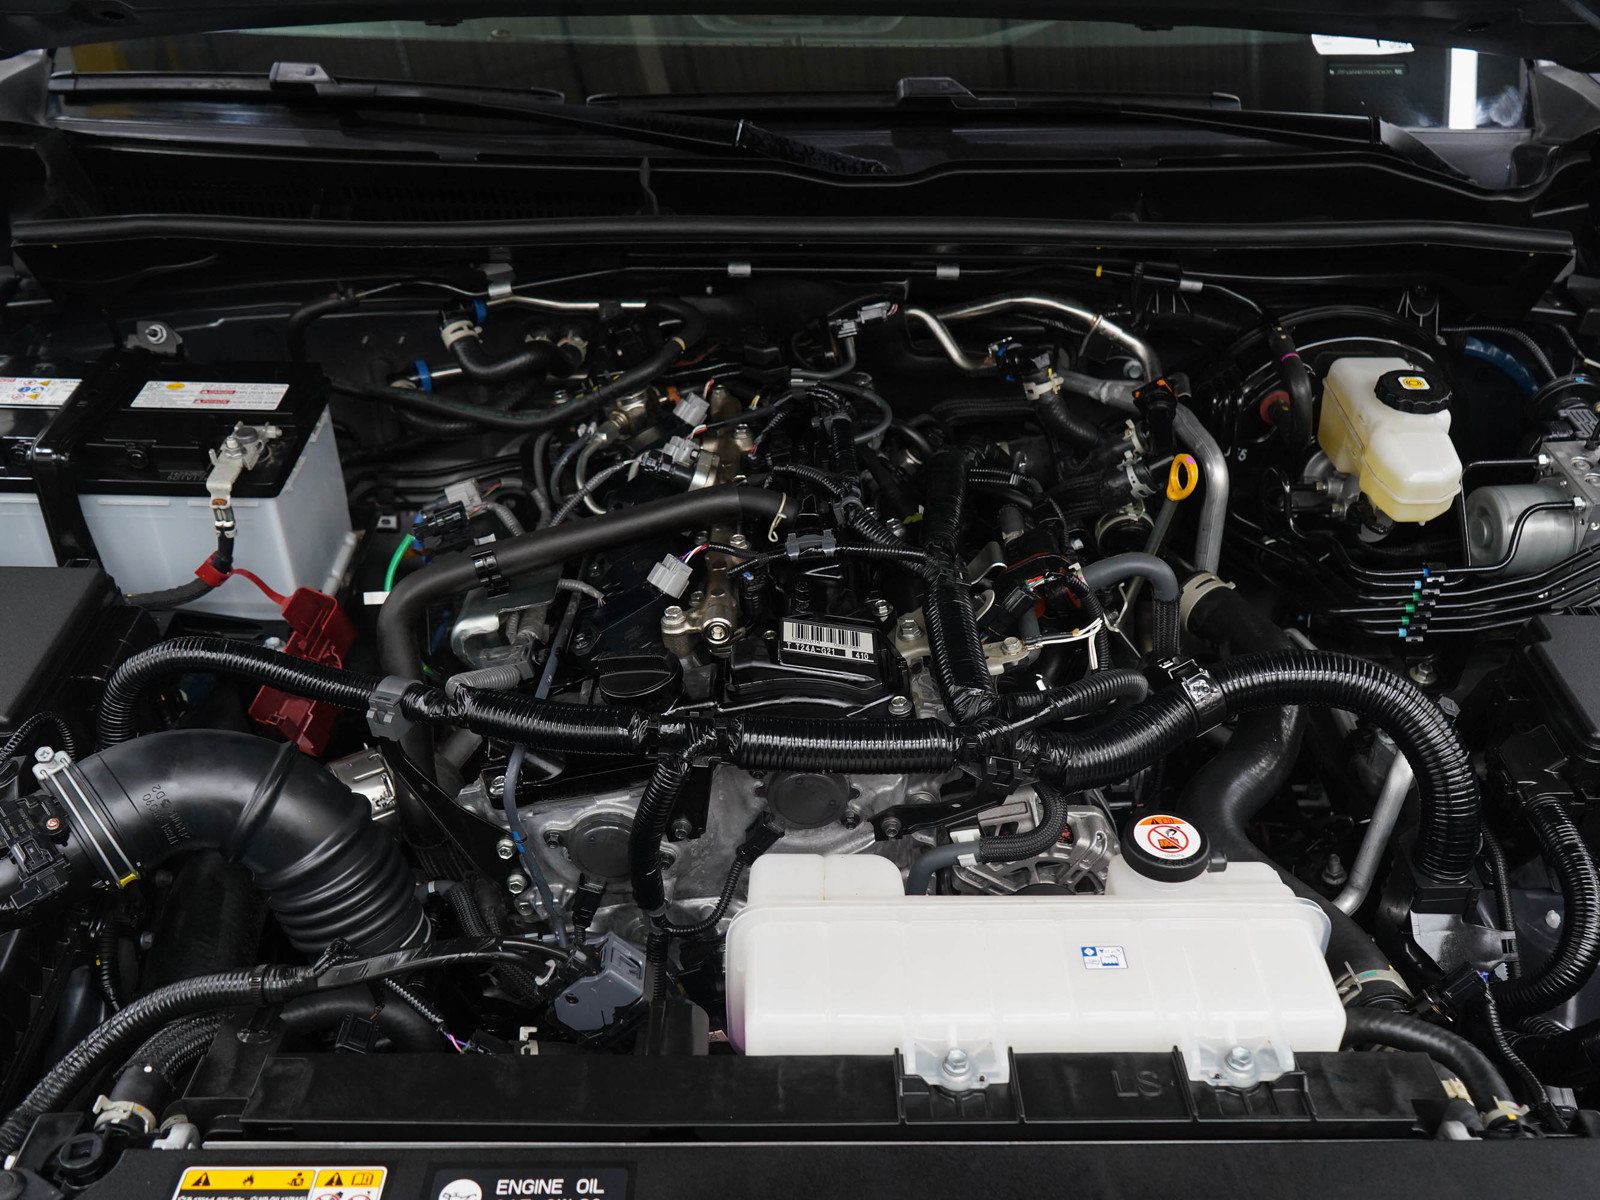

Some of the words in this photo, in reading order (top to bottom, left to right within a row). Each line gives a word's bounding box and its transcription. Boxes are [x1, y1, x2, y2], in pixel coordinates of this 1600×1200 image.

[1111, 1070, 1162, 1098] LS
[495, 1178, 565, 1195] ENGINE
[575, 1177, 605, 1195] OIL
